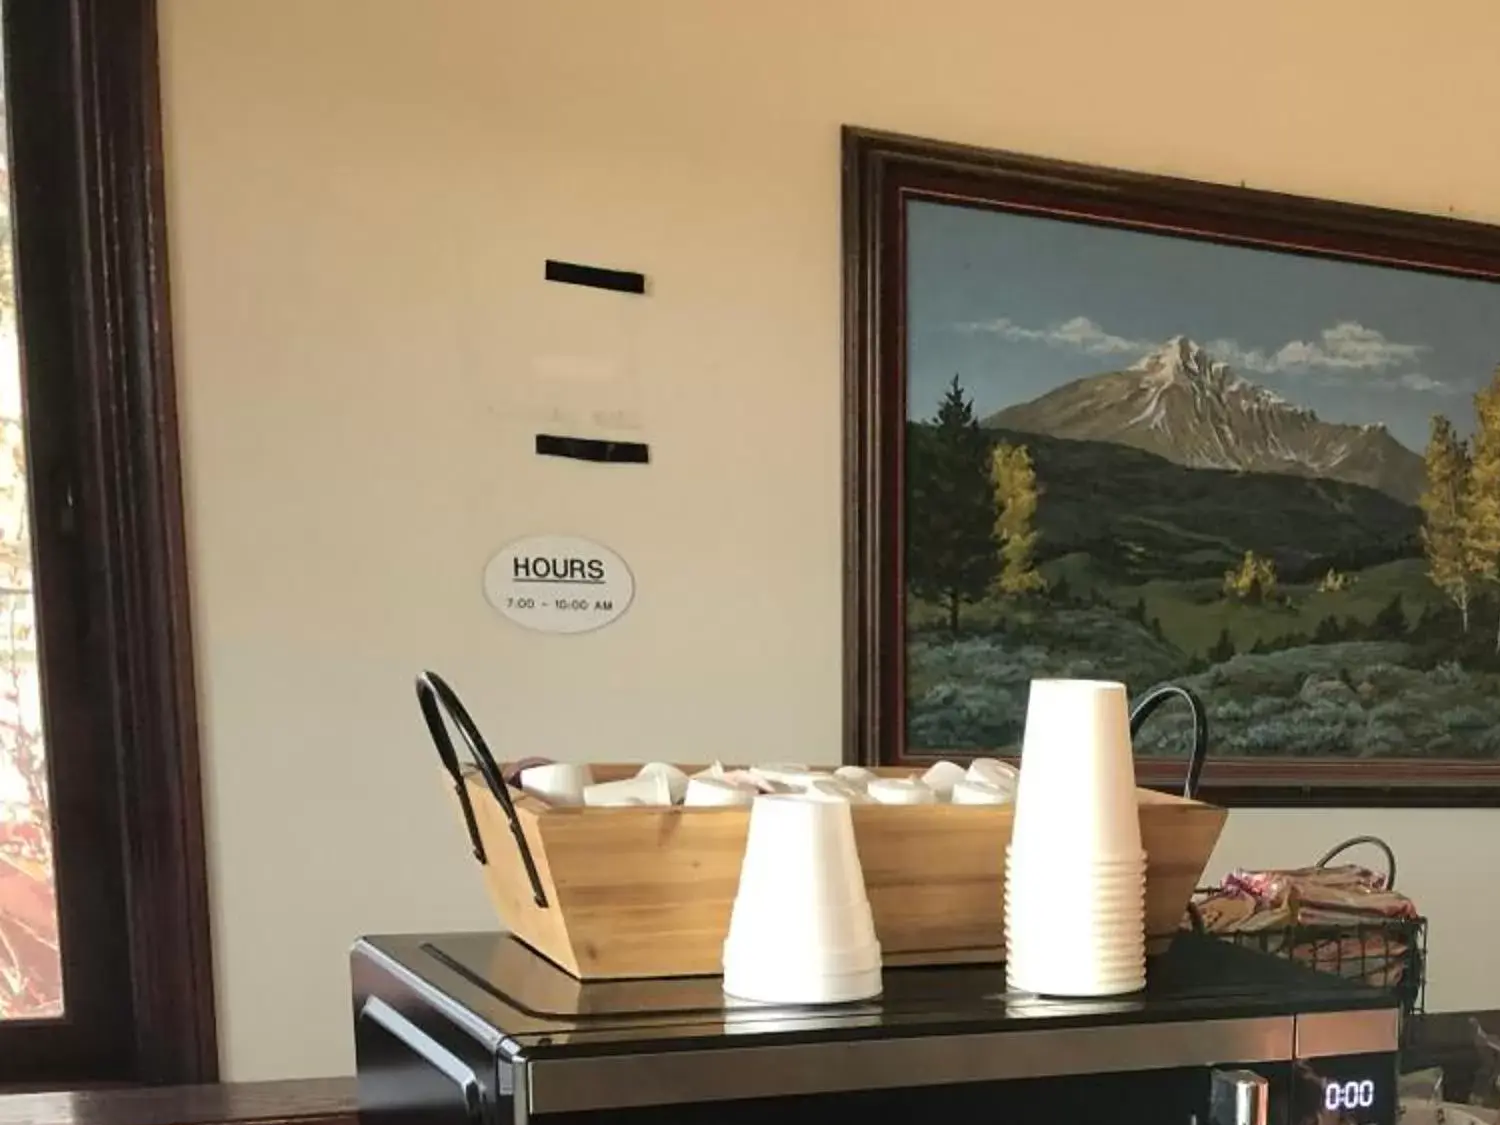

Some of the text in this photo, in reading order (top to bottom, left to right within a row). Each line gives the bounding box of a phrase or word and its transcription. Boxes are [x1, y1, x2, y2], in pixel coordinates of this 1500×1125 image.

[513, 557, 605, 579] HOURS
[554, 599, 589, 611] 10:00
[593, 600, 613, 611] AM
[1325, 1079, 1375, 1110] 0:00
